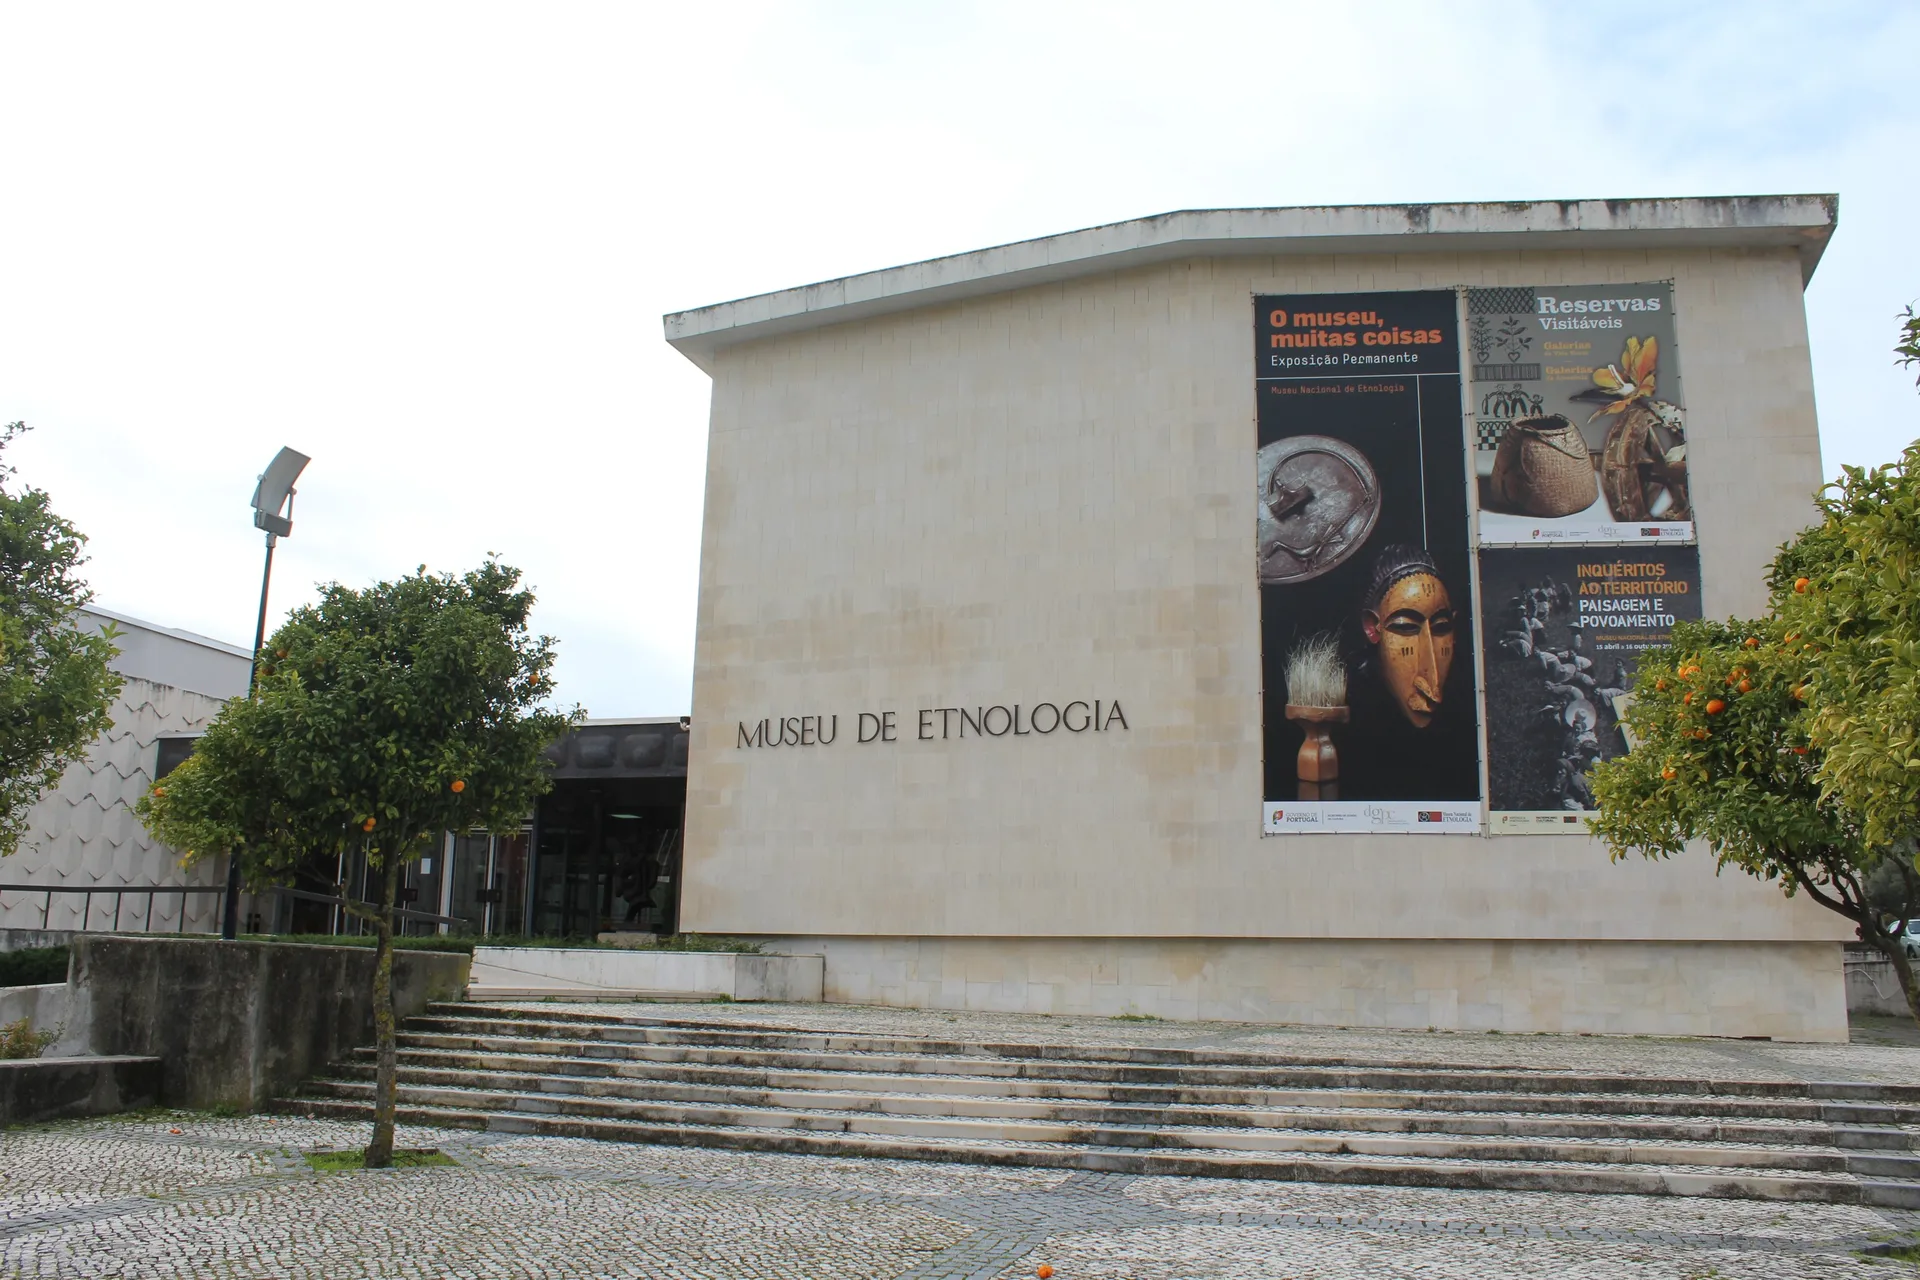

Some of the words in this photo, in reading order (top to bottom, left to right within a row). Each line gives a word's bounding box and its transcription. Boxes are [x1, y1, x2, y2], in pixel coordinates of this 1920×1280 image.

[1537, 296, 1661, 314] Reservas
[1270, 309, 1287, 327] O
[1293, 310, 1384, 328] museu,
[1539, 316, 1623, 330] Visitáveis
[1271, 329, 1357, 348] muitas
[1363, 327, 1442, 346] coisas
[1271, 354, 1339, 368] Exposição
[1343, 352, 1418, 364] Permanente
[1271, 386, 1297, 395] Museu
[1300, 385, 1341, 394] Nacional
[1344, 384, 1355, 393] de
[1357, 384, 1405, 393] Etnologia
[1577, 560, 1666, 577] INQUÉRITOS
[1579, 582, 1600, 595] AO
[1601, 577, 1688, 595] TERRITÓRIO
[1580, 599, 1650, 612] PAISAGEM
[1654, 598, 1664, 611] E
[1580, 614, 1675, 628] POVOAMENTO
[736, 714, 837, 749] MUSEU
[857, 711, 897, 743] DE
[917, 699, 1129, 741] ETNOLOGIA
